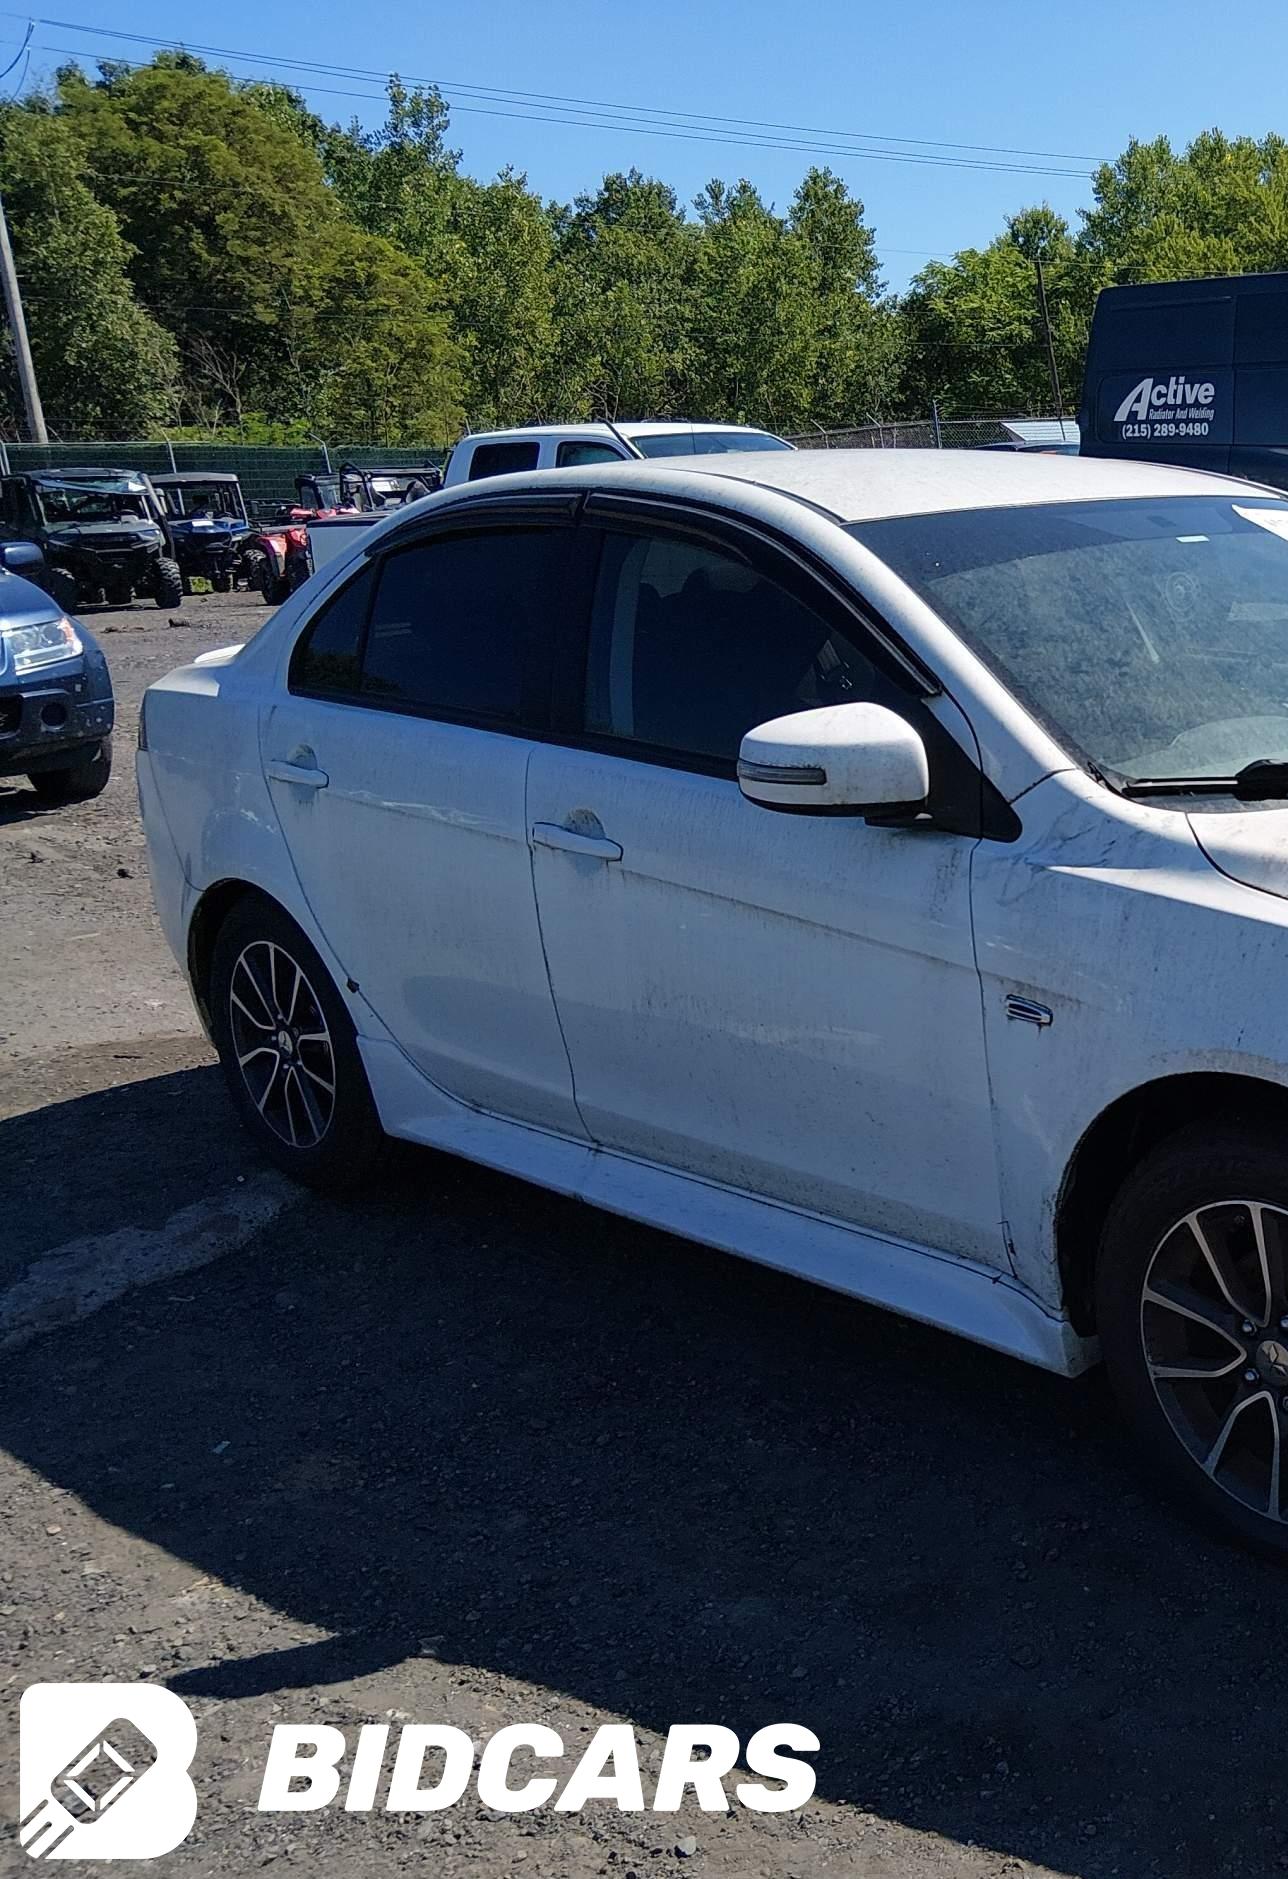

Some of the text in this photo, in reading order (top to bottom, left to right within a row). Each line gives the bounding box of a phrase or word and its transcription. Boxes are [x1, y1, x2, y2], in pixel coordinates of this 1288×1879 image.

[1114, 376, 1215, 422] Active
[1149, 407, 1214, 421] Radiator And Welding
[1122, 422, 1209, 440] (215) 289-9480
